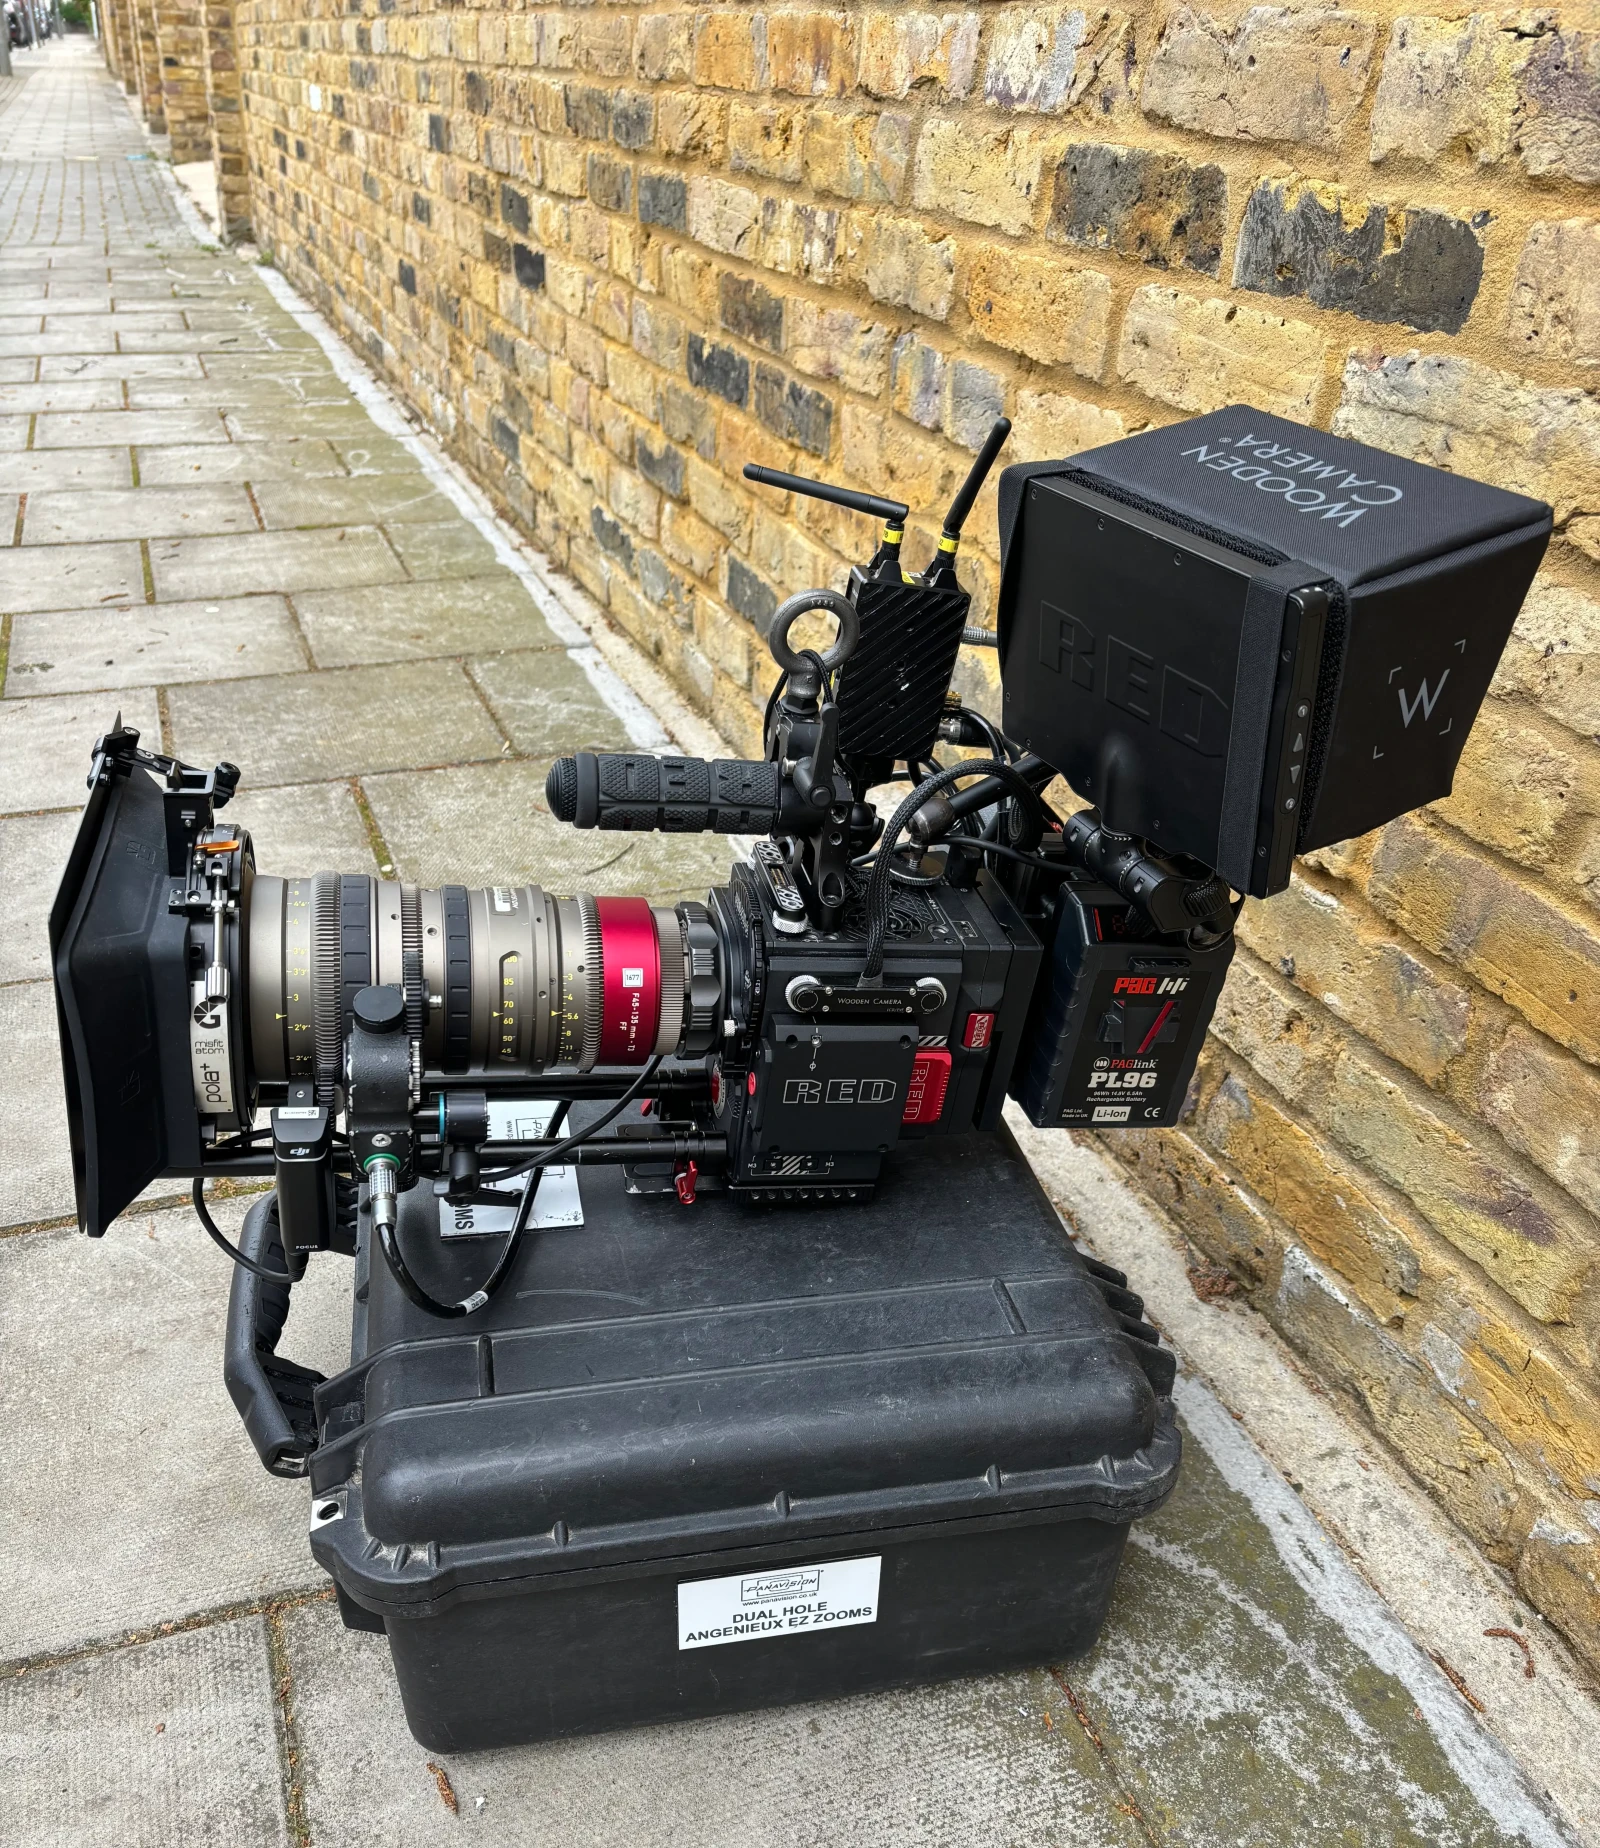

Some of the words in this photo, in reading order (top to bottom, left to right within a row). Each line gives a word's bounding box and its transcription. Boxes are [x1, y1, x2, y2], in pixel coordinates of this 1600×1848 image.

[1180, 445, 1369, 528] WOODEN
[1039, 600, 1229, 757] RED
[1398, 668, 1450, 728] W
[503, 977, 514, 986] 85
[567, 973, 574, 981] 3
[293, 993, 300, 1001] 3
[567, 993, 574, 1001] 4
[503, 1000, 514, 1008] 70
[503, 1017, 514, 1025] 60
[567, 1012, 579, 1020] 5.6
[619, 1021, 628, 1031] FF
[194, 1039, 224, 1048] misfit
[195, 1047, 225, 1055] atom
[200, 1063, 228, 1103] pola+
[1087, 1071, 1158, 1088] PL96
[783, 1079, 897, 1104] RED
[903, 1061, 930, 1120] RED
[1096, 1109, 1127, 1118] Li-Ion
[743, 1577, 818, 1593] PANAVISION
[742, 1591, 818, 1607] www.panavision.co.uk
[732, 1609, 779, 1624] DUAL
[782, 1601, 828, 1617] HOLE
[685, 1619, 784, 1643] ANGENIEUX
[788, 1614, 809, 1628] EZ
[812, 1606, 873, 1625] ZOOMS
